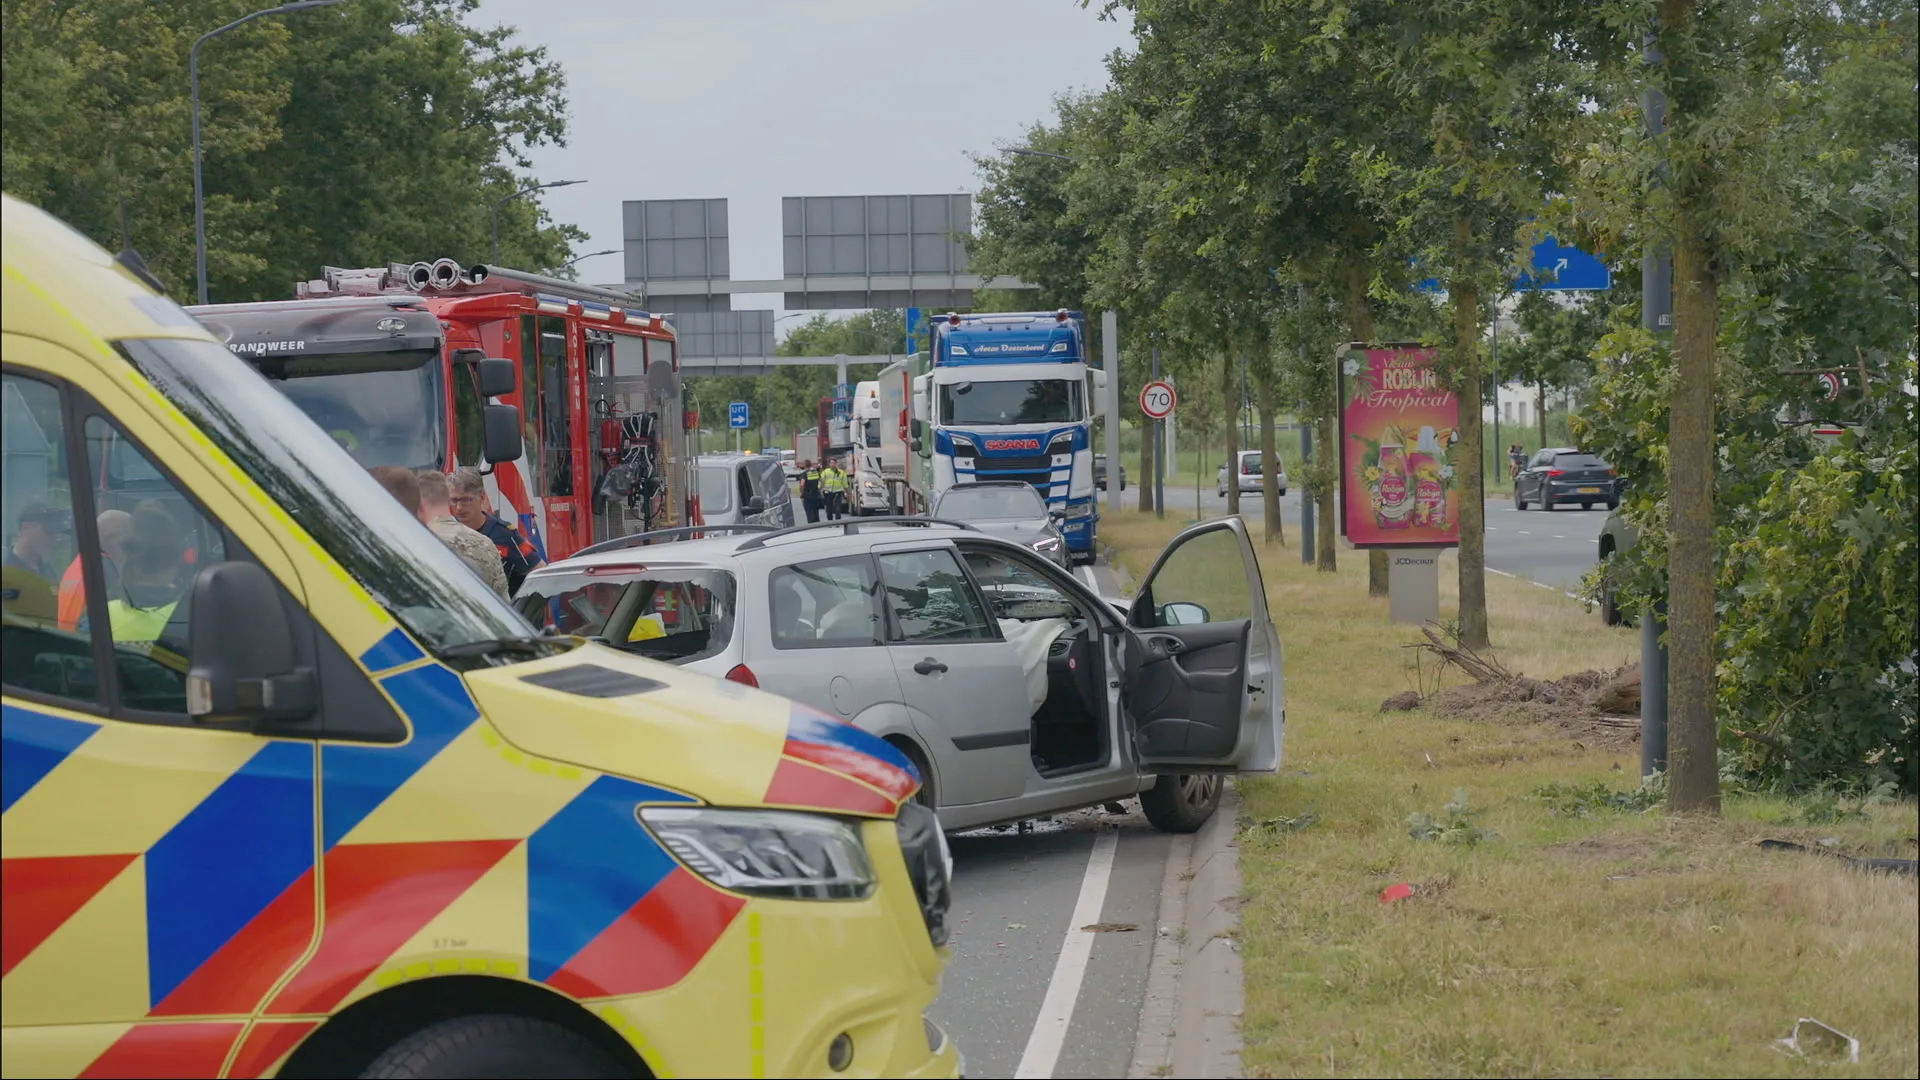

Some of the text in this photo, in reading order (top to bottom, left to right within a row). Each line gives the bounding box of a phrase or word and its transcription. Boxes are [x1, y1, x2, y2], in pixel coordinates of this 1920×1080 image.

[1147, 392, 1170, 406] 70
[1368, 390, 1451, 414] Tropical
[731, 405, 746, 414] UIT
[985, 439, 1041, 451] SCANIA
[1395, 556, 1434, 566] JCDecaux
